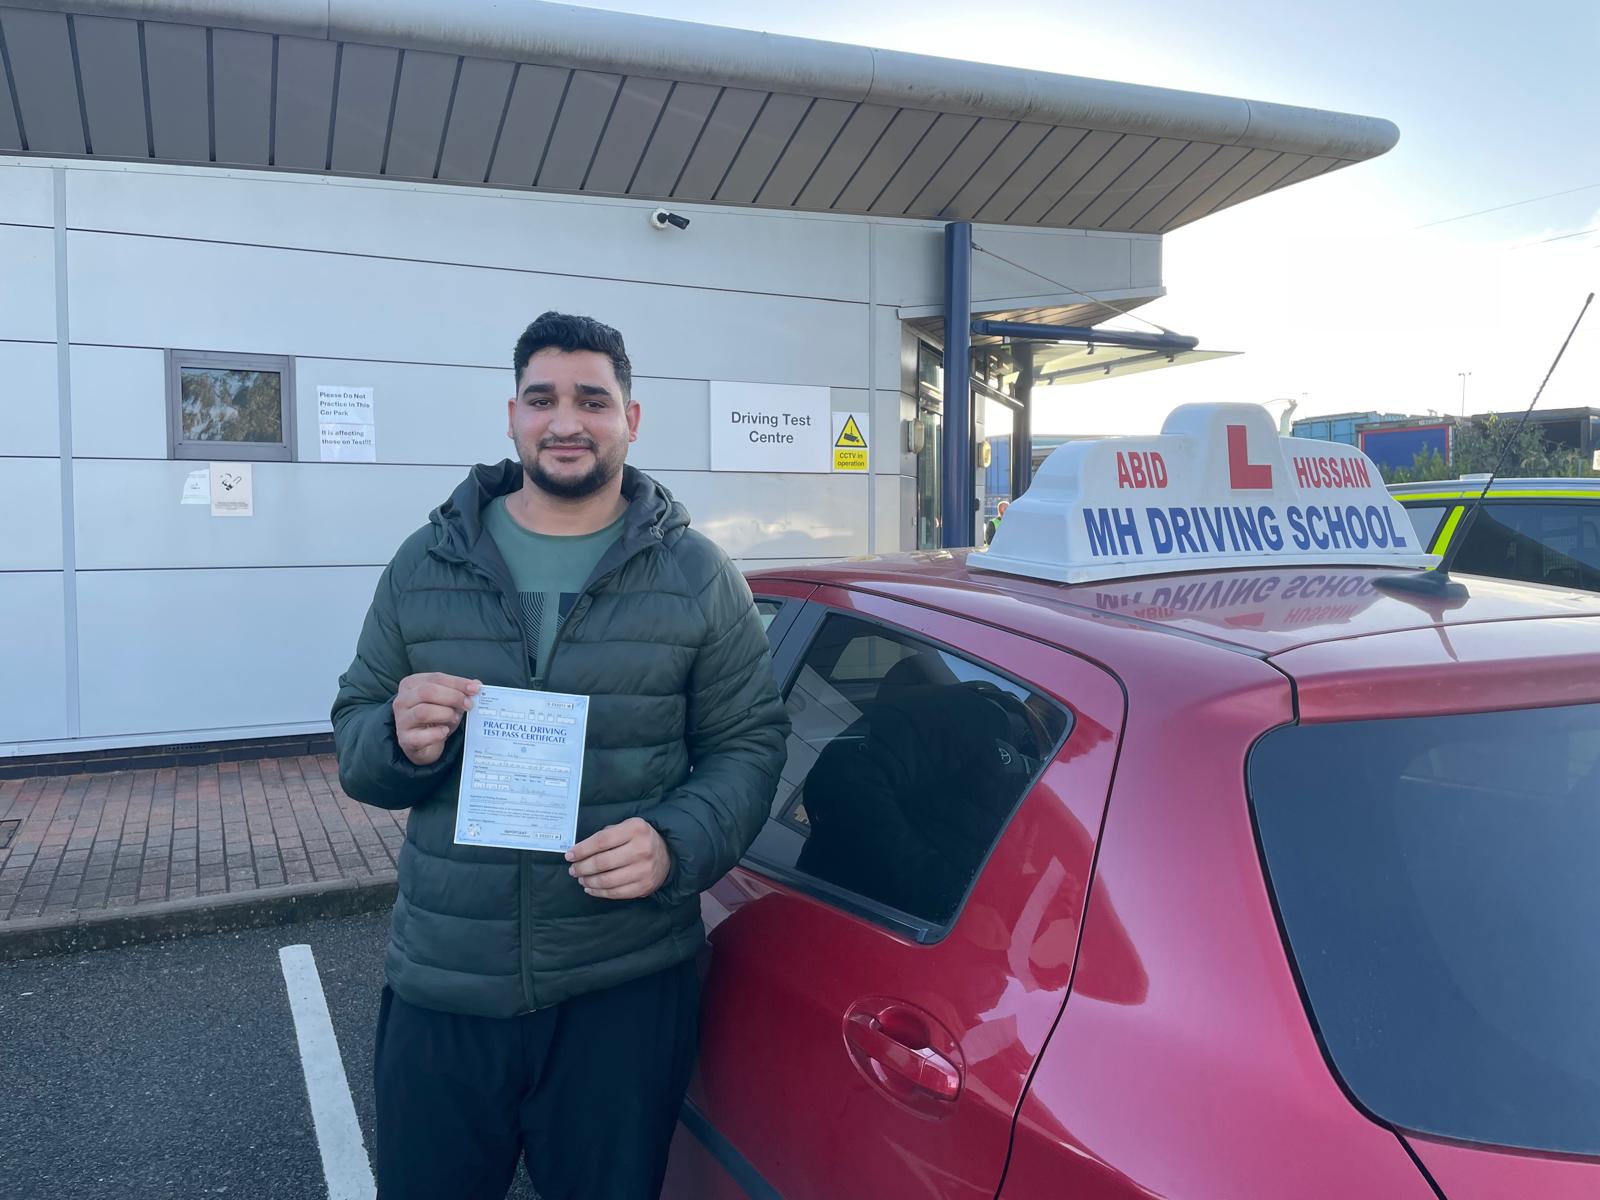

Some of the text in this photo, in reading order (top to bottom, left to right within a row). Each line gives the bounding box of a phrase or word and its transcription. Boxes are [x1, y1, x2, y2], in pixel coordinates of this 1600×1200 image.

[731, 412, 811, 428] Driving Test
[749, 431, 794, 443] Centre
[1227, 424, 1272, 489] L
[1116, 451, 1168, 489] ABID
[1293, 457, 1372, 489] HUSSAIN
[1083, 505, 1408, 556] MH DRIVING SCHOOL
[483, 721, 567, 736] PRACTICAL DRIVING
[501, 731, 519, 739] PASS
[520, 733, 566, 744] CERTIFICATE
